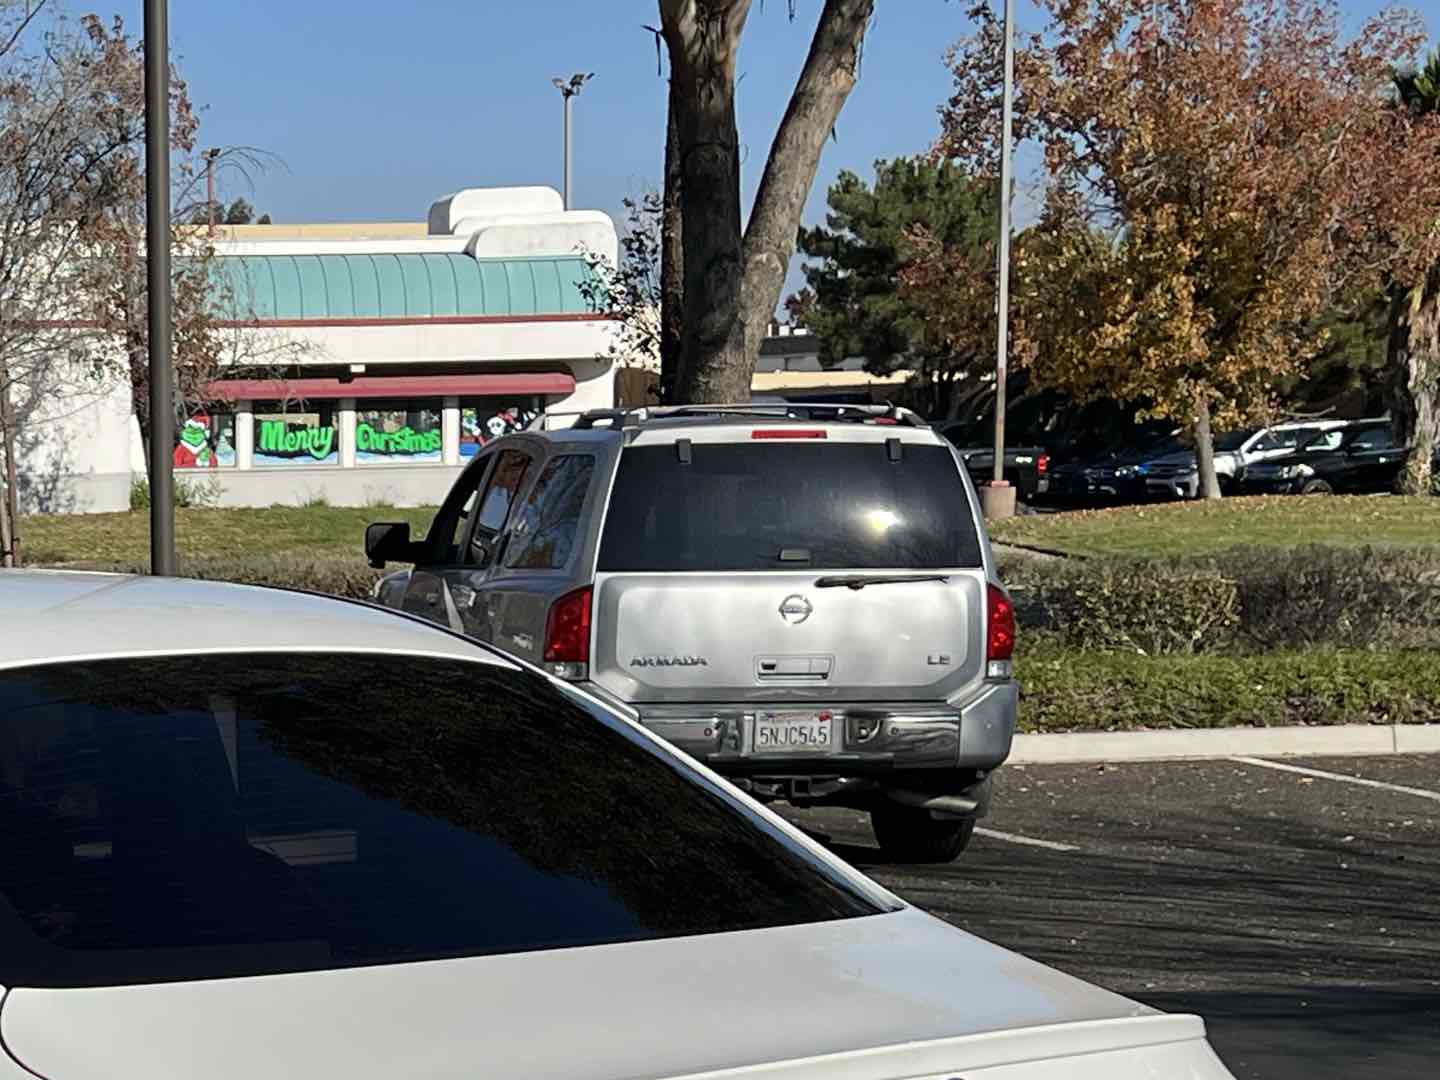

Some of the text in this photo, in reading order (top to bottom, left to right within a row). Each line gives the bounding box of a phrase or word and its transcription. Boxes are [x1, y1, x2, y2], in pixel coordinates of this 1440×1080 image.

[357, 423, 441, 452] Christmas
[630, 656, 707, 667] ARMADA
[927, 655, 951, 665] LE
[760, 726, 827, 745] 5NJC545
